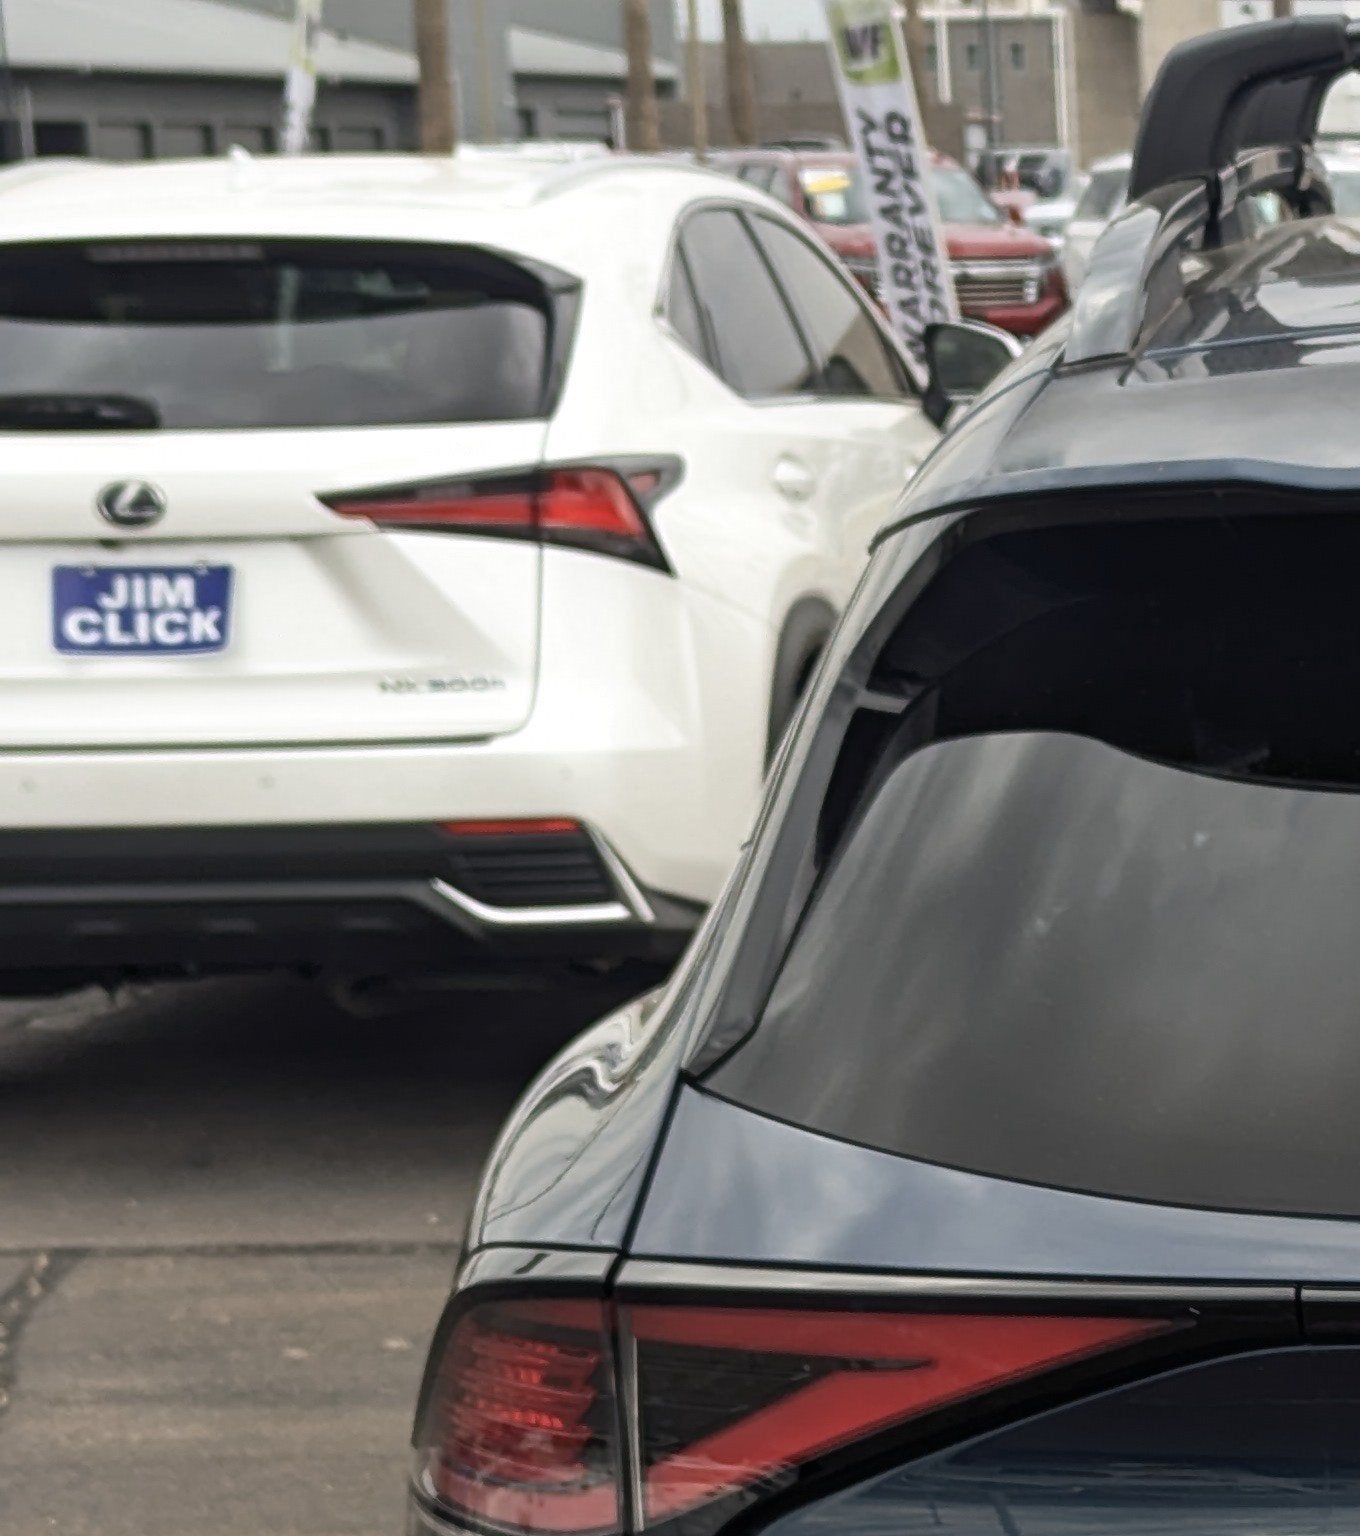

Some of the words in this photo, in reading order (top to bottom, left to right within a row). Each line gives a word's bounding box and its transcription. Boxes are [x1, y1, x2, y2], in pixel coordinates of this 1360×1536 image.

[885, 111, 949, 321] OREVER
[97, 573, 195, 610] JIM
[62, 606, 222, 646] CLICK
